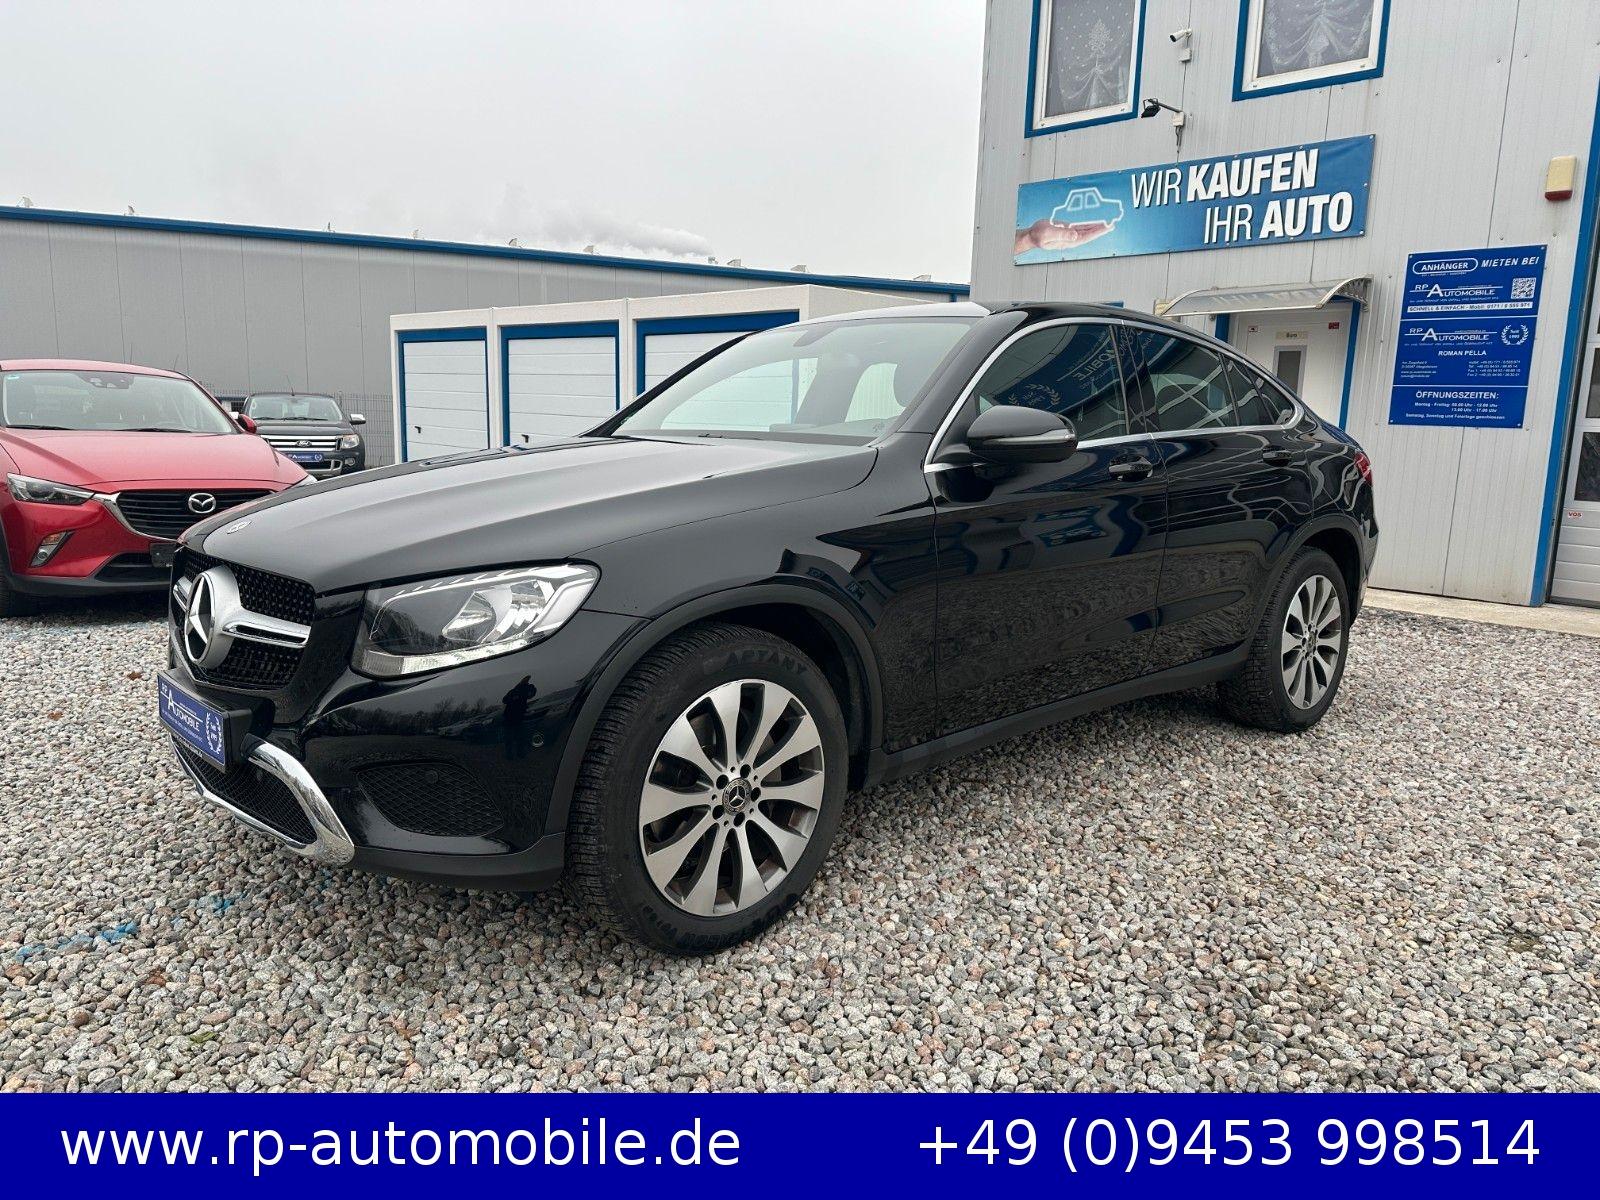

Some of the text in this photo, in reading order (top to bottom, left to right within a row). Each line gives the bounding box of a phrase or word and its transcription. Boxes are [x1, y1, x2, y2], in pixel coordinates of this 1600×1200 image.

[1131, 149, 1319, 208] WIR KAUFEN
[1204, 191, 1353, 244] IHR AUTO
[1421, 262, 1469, 272] ANHÄNGER
[1481, 256, 1539, 268] MIETEN BEI
[1414, 284, 1429, 292] RP
[1427, 284, 1496, 297] AUTOMOBILE
[1421, 327, 1489, 341] AUTOMOBILE
[1415, 390, 1500, 399] ÖFFNUNGSZEITEN:
